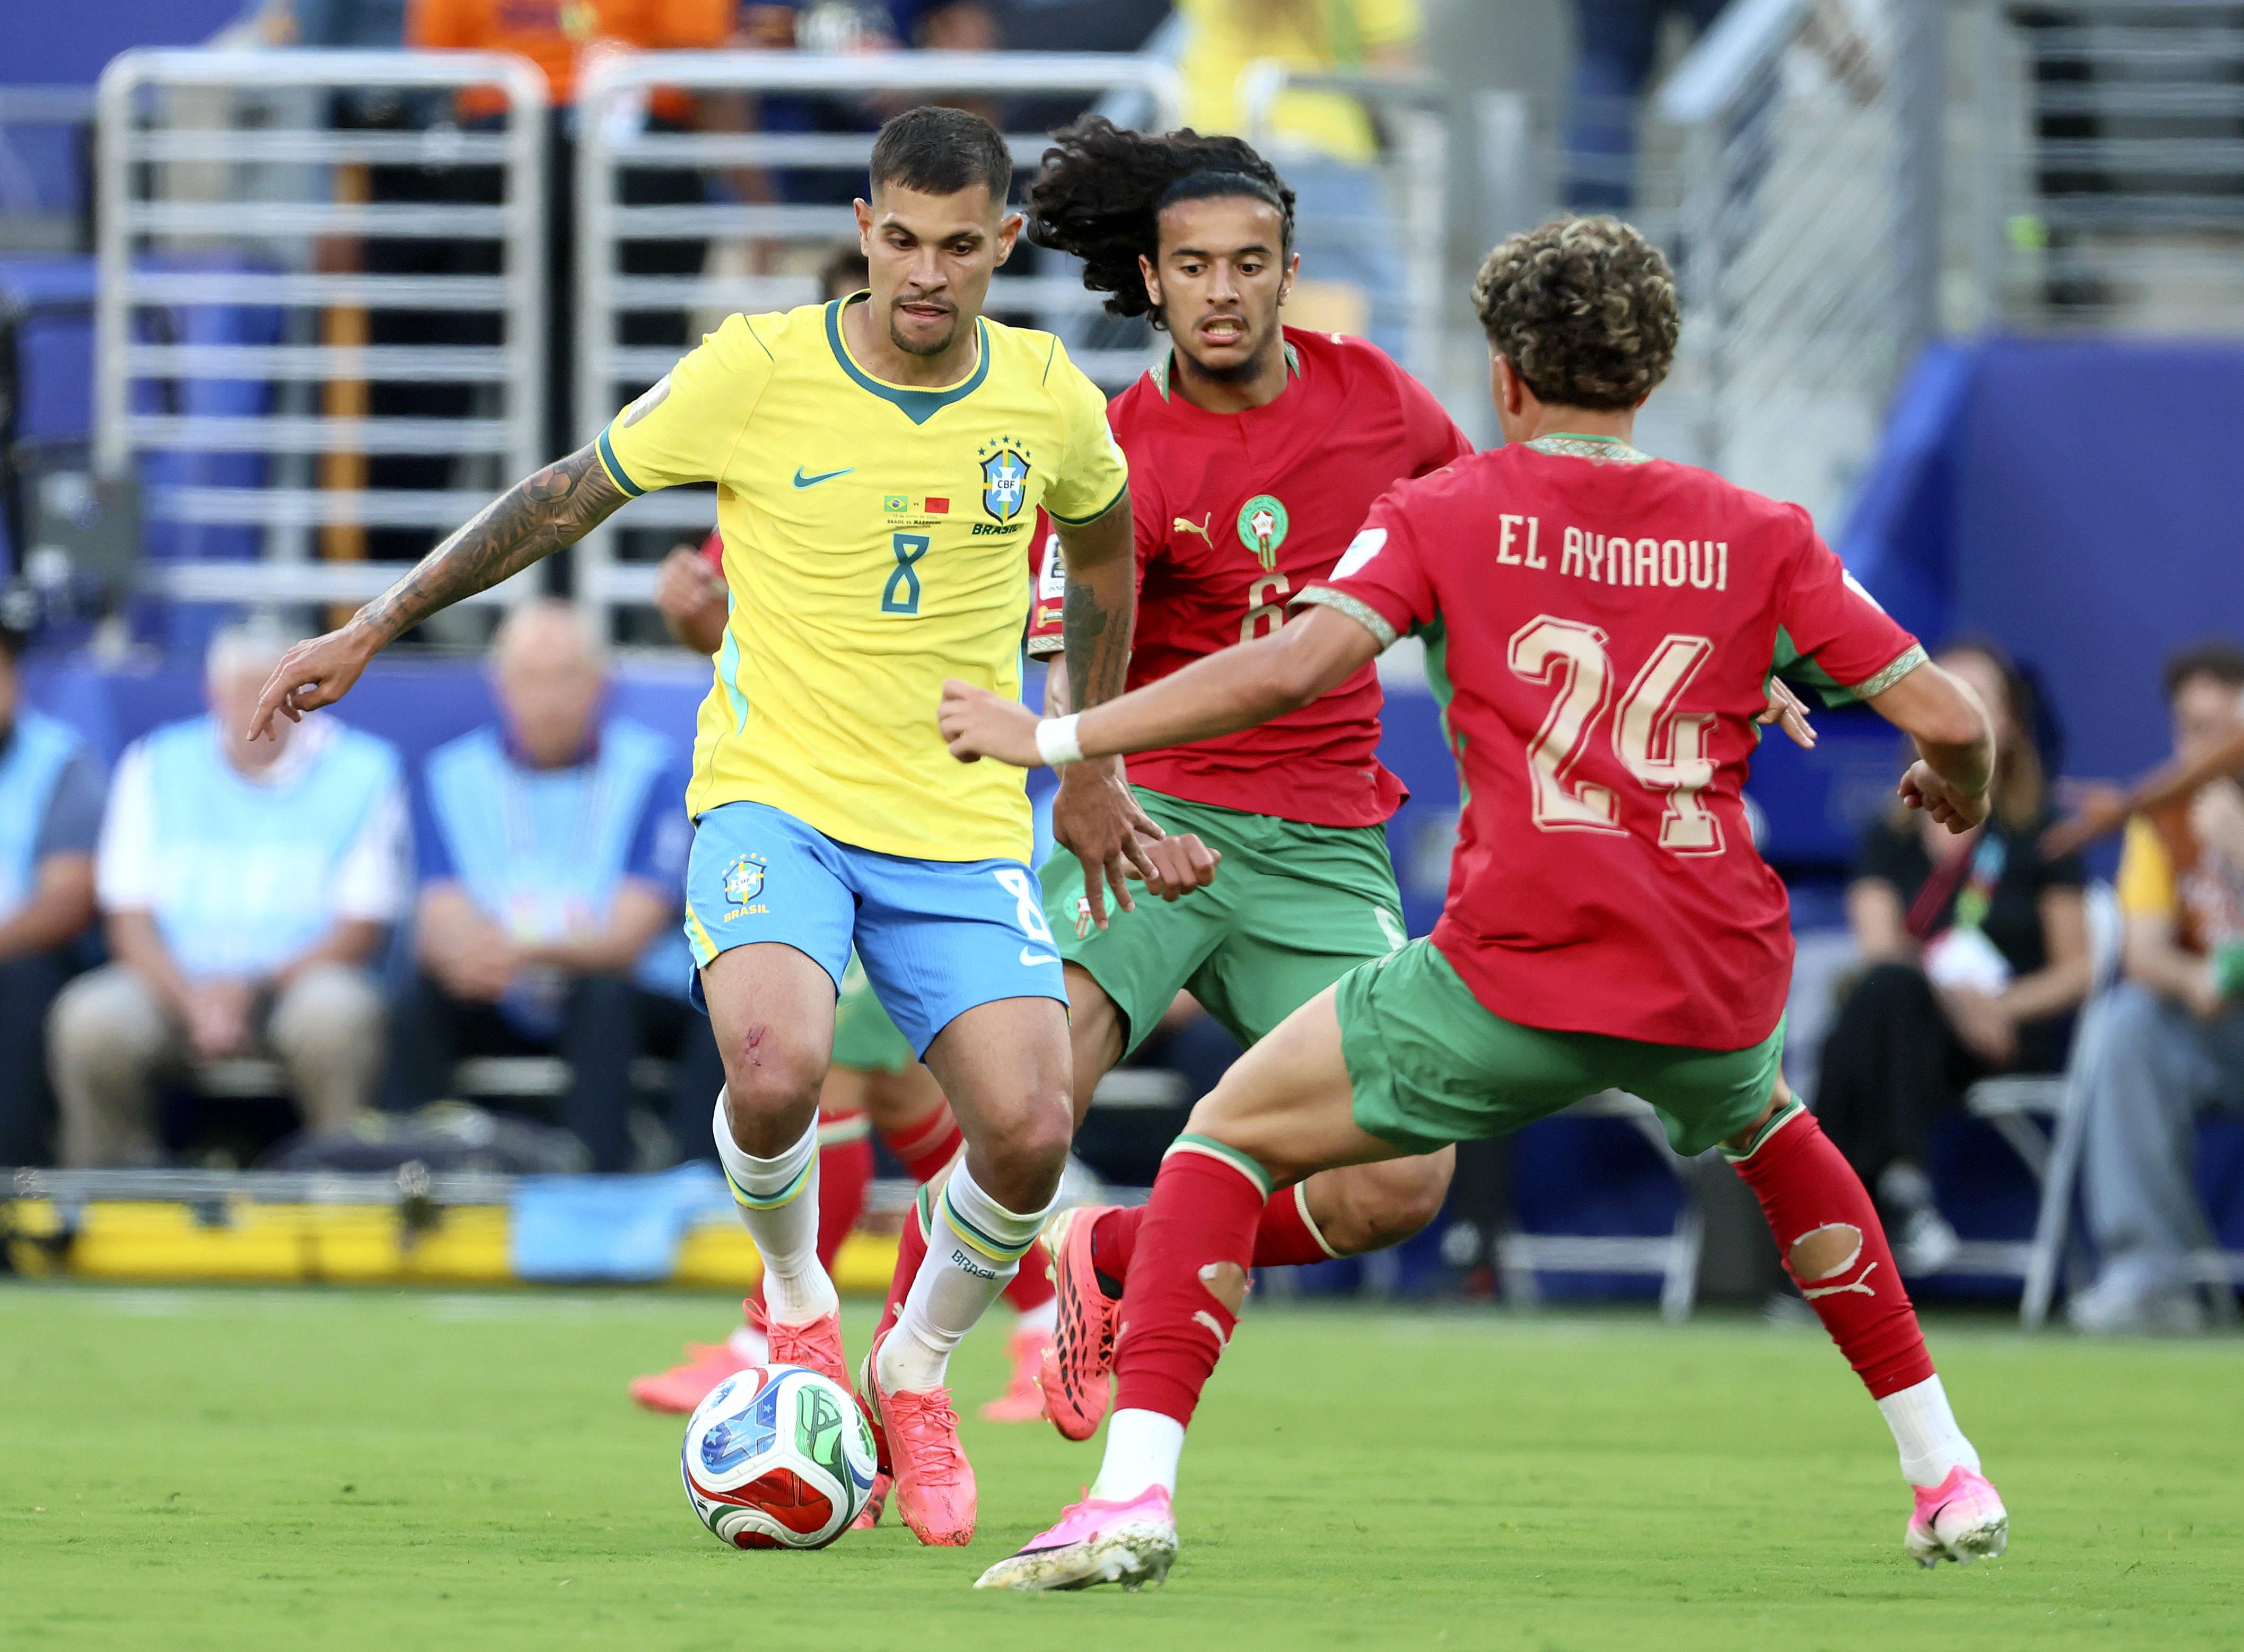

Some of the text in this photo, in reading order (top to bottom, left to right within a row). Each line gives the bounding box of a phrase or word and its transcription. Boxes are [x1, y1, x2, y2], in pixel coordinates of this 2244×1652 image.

[997, 480, 1015, 489] CBF
[971, 523, 1018, 535] BRASIL
[1495, 513, 1729, 592] EL AYNAOUI
[881, 532, 931, 614] 8
[1239, 573, 1290, 643] 6
[1507, 613, 1725, 857] 24
[723, 903, 770, 924] BRASIL
[993, 869, 1056, 945] 8
[951, 1248, 998, 1280] BRASIL
